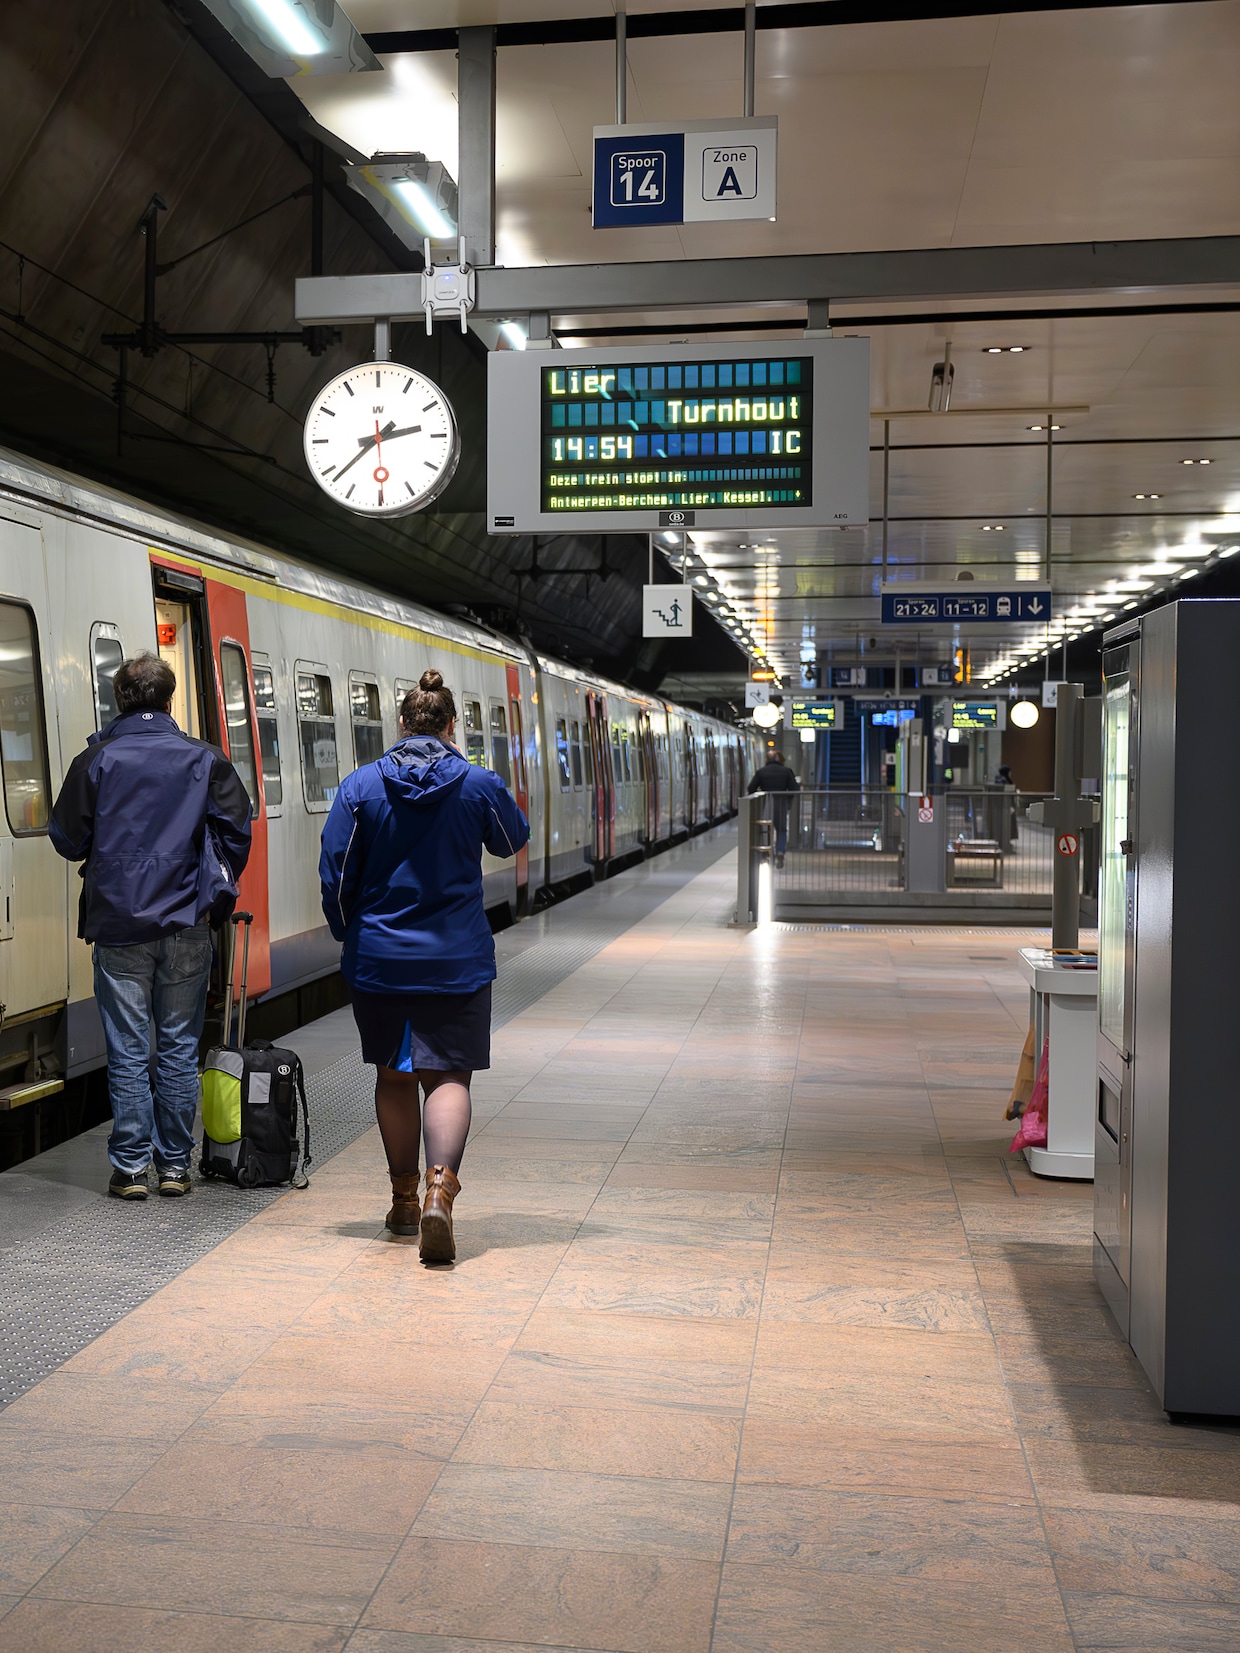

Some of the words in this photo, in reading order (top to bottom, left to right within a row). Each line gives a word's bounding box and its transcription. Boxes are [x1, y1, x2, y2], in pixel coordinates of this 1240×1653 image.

[618, 156, 658, 171] Spoor
[713, 150, 747, 163] Zone
[619, 169, 659, 201] 14
[716, 166, 743, 196] A
[550, 371, 616, 395] Lier
[667, 396, 800, 425] Turnhout
[553, 435, 633, 461] 14:54
[771, 430, 802, 455] IC
[550, 474, 578, 486] Deze
[585, 473, 619, 485] trein
[625, 472, 660, 484] stopt
[668, 471, 687, 483] in:
